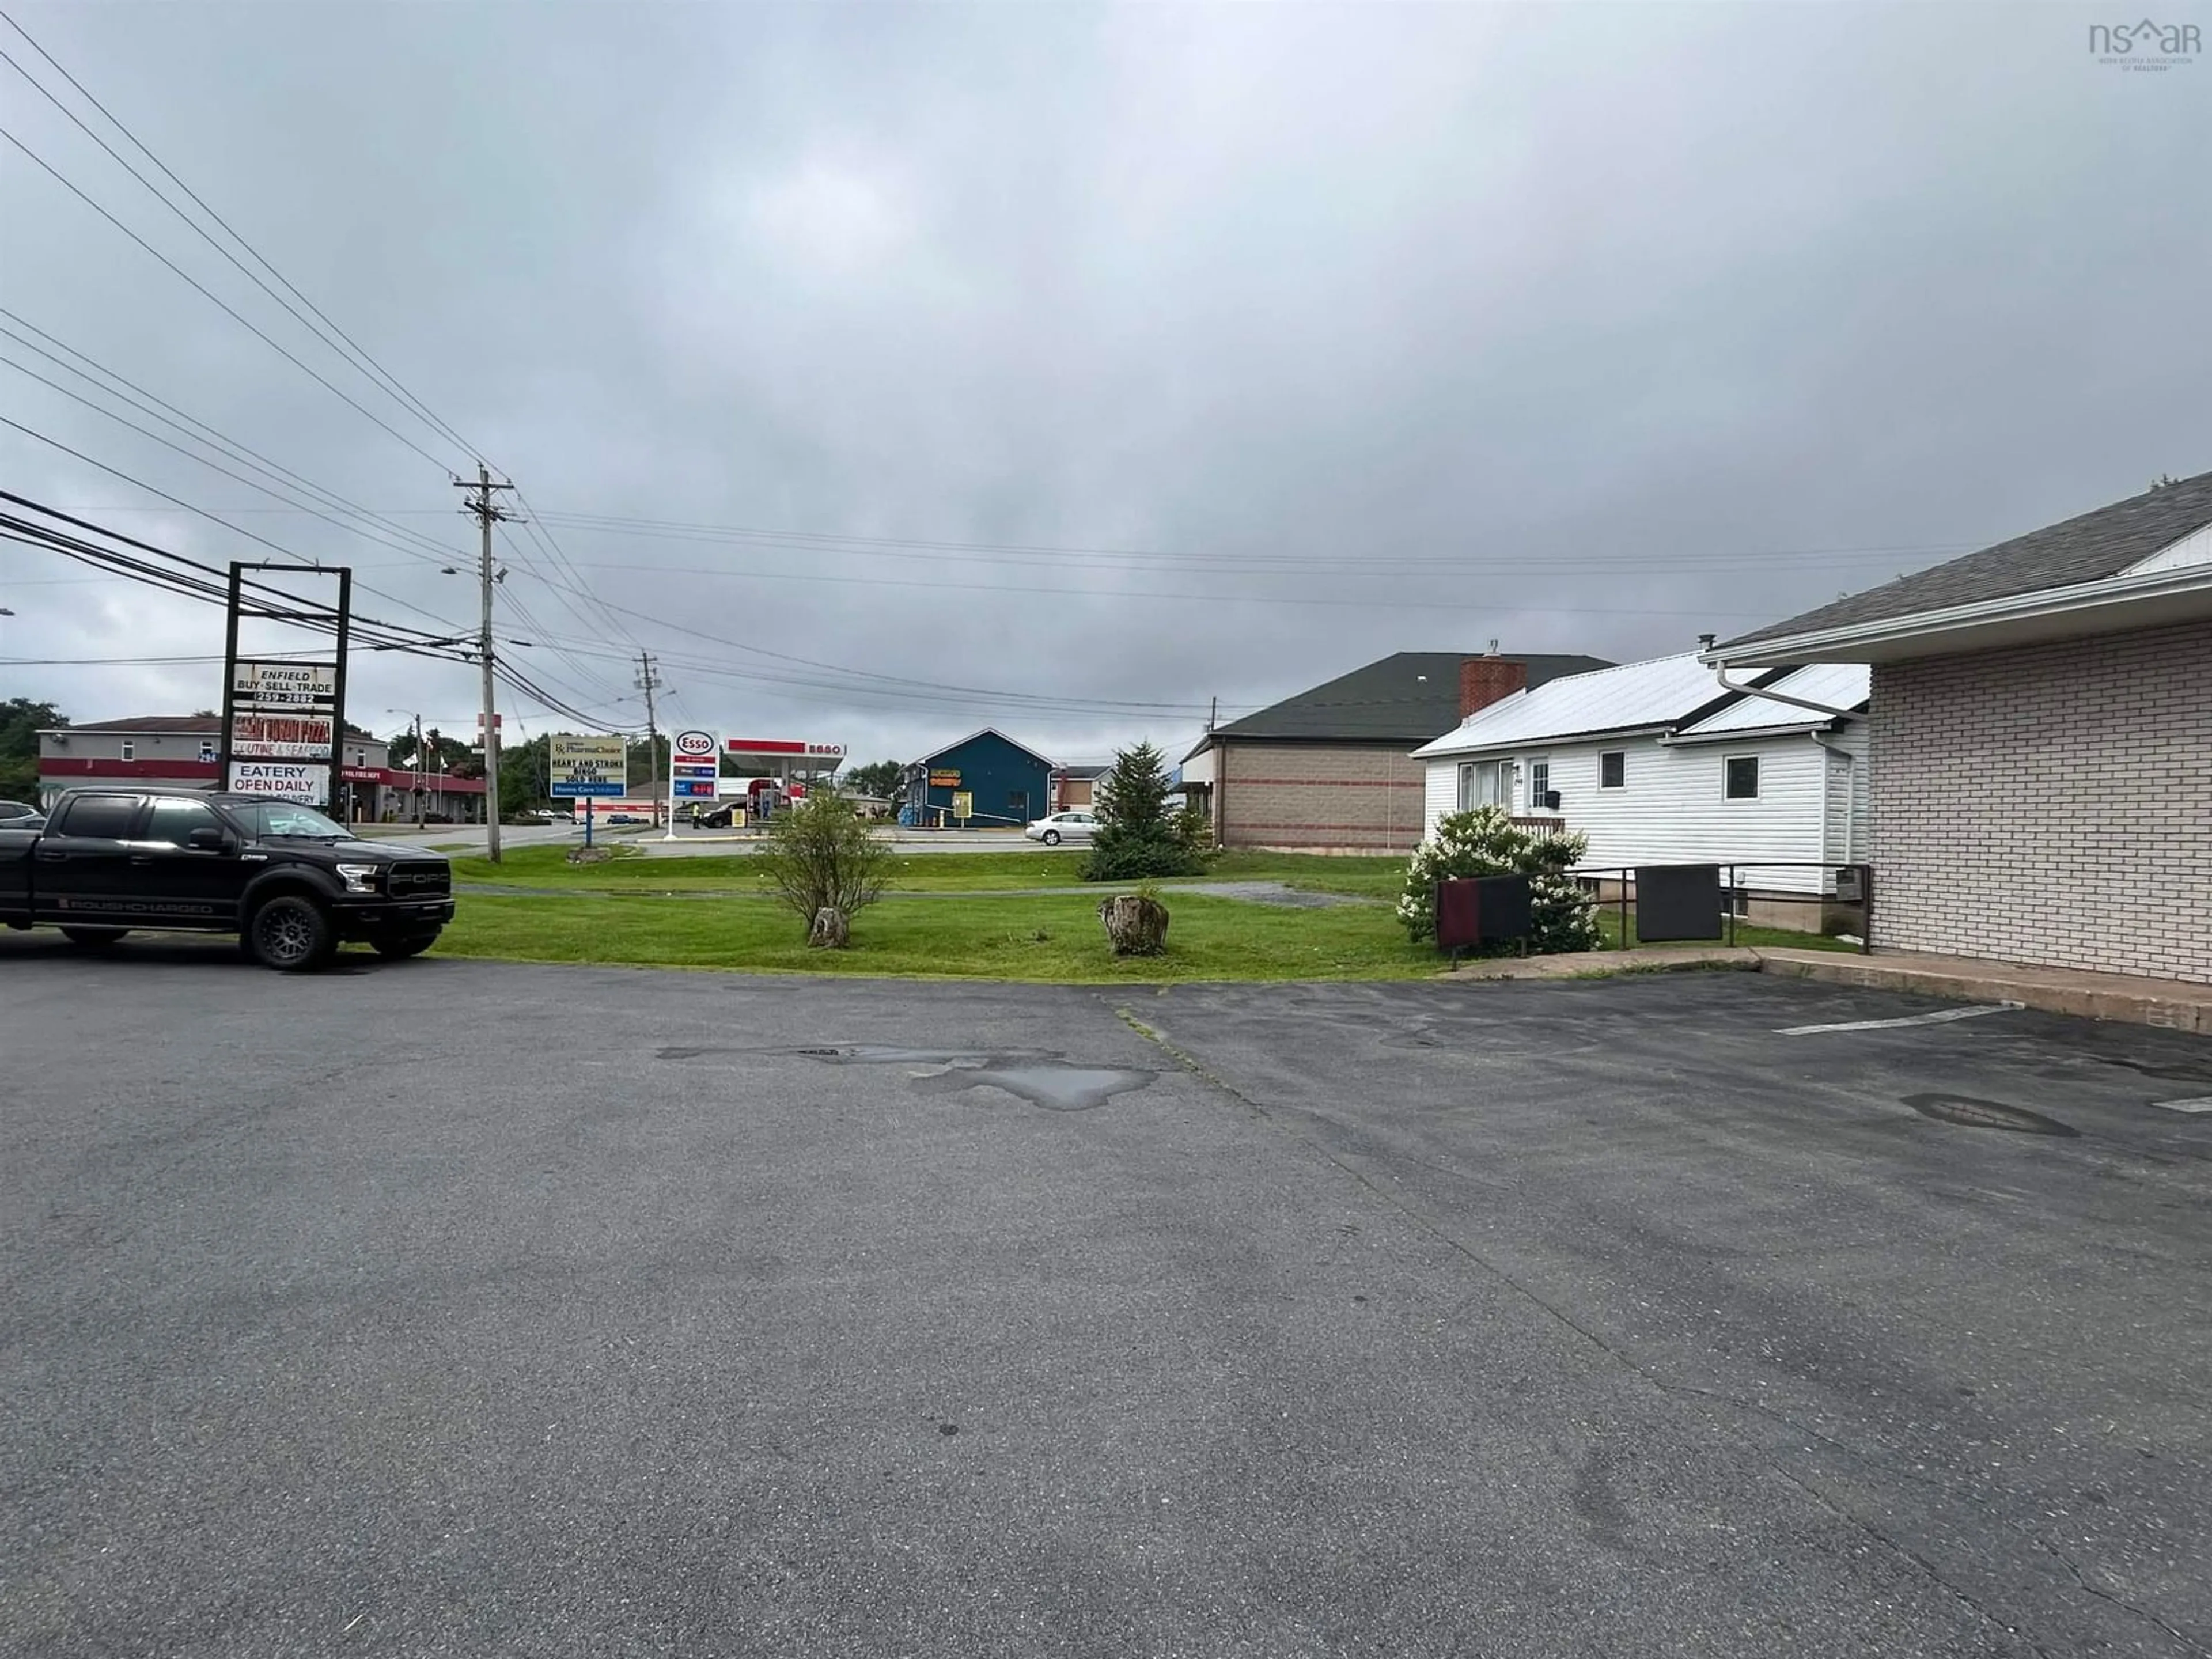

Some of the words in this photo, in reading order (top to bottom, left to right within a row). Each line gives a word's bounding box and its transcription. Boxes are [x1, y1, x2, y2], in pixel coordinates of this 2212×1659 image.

[261, 671, 310, 681] ENFIELD
[240, 766, 306, 777] EATERY
[235, 779, 272, 790] OPEN
[275, 781, 314, 791] DAILY
